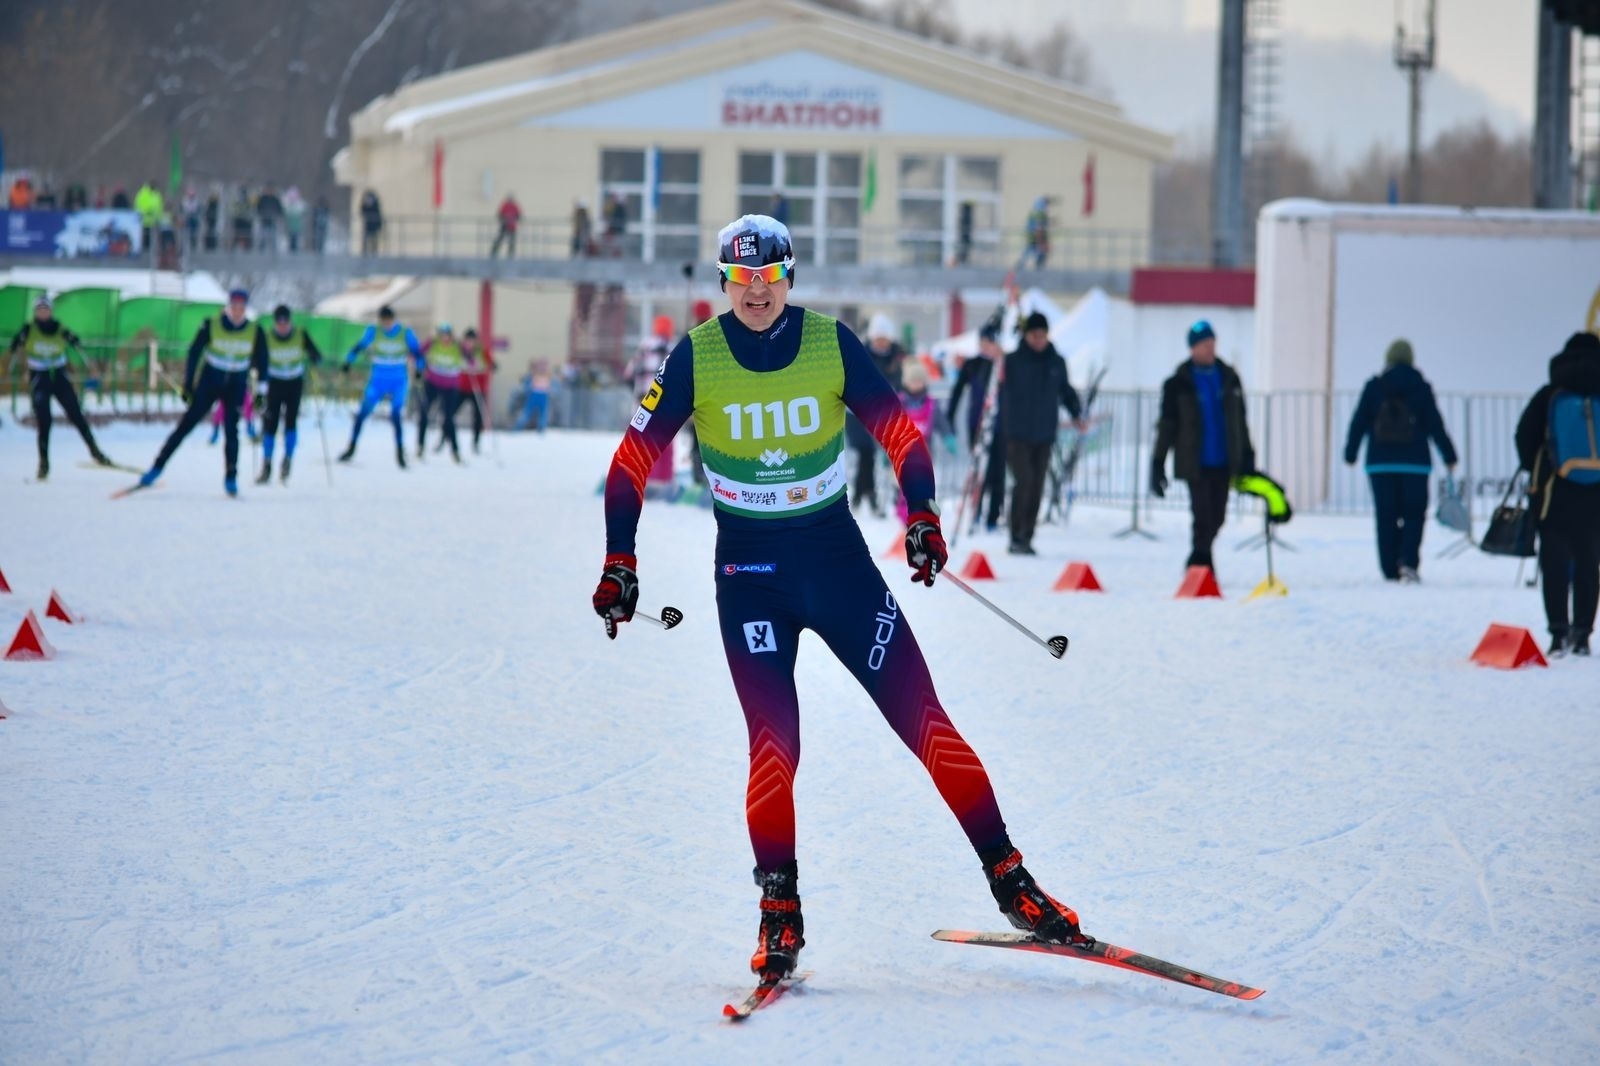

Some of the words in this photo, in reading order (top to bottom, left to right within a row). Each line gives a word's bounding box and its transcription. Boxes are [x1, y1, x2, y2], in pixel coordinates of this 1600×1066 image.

[722, 101, 881, 127] БИАТЛОН
[722, 396, 820, 440] 1110
[755, 467, 796, 477] УФИМСКИЙ
[868, 591, 897, 671] odlo
